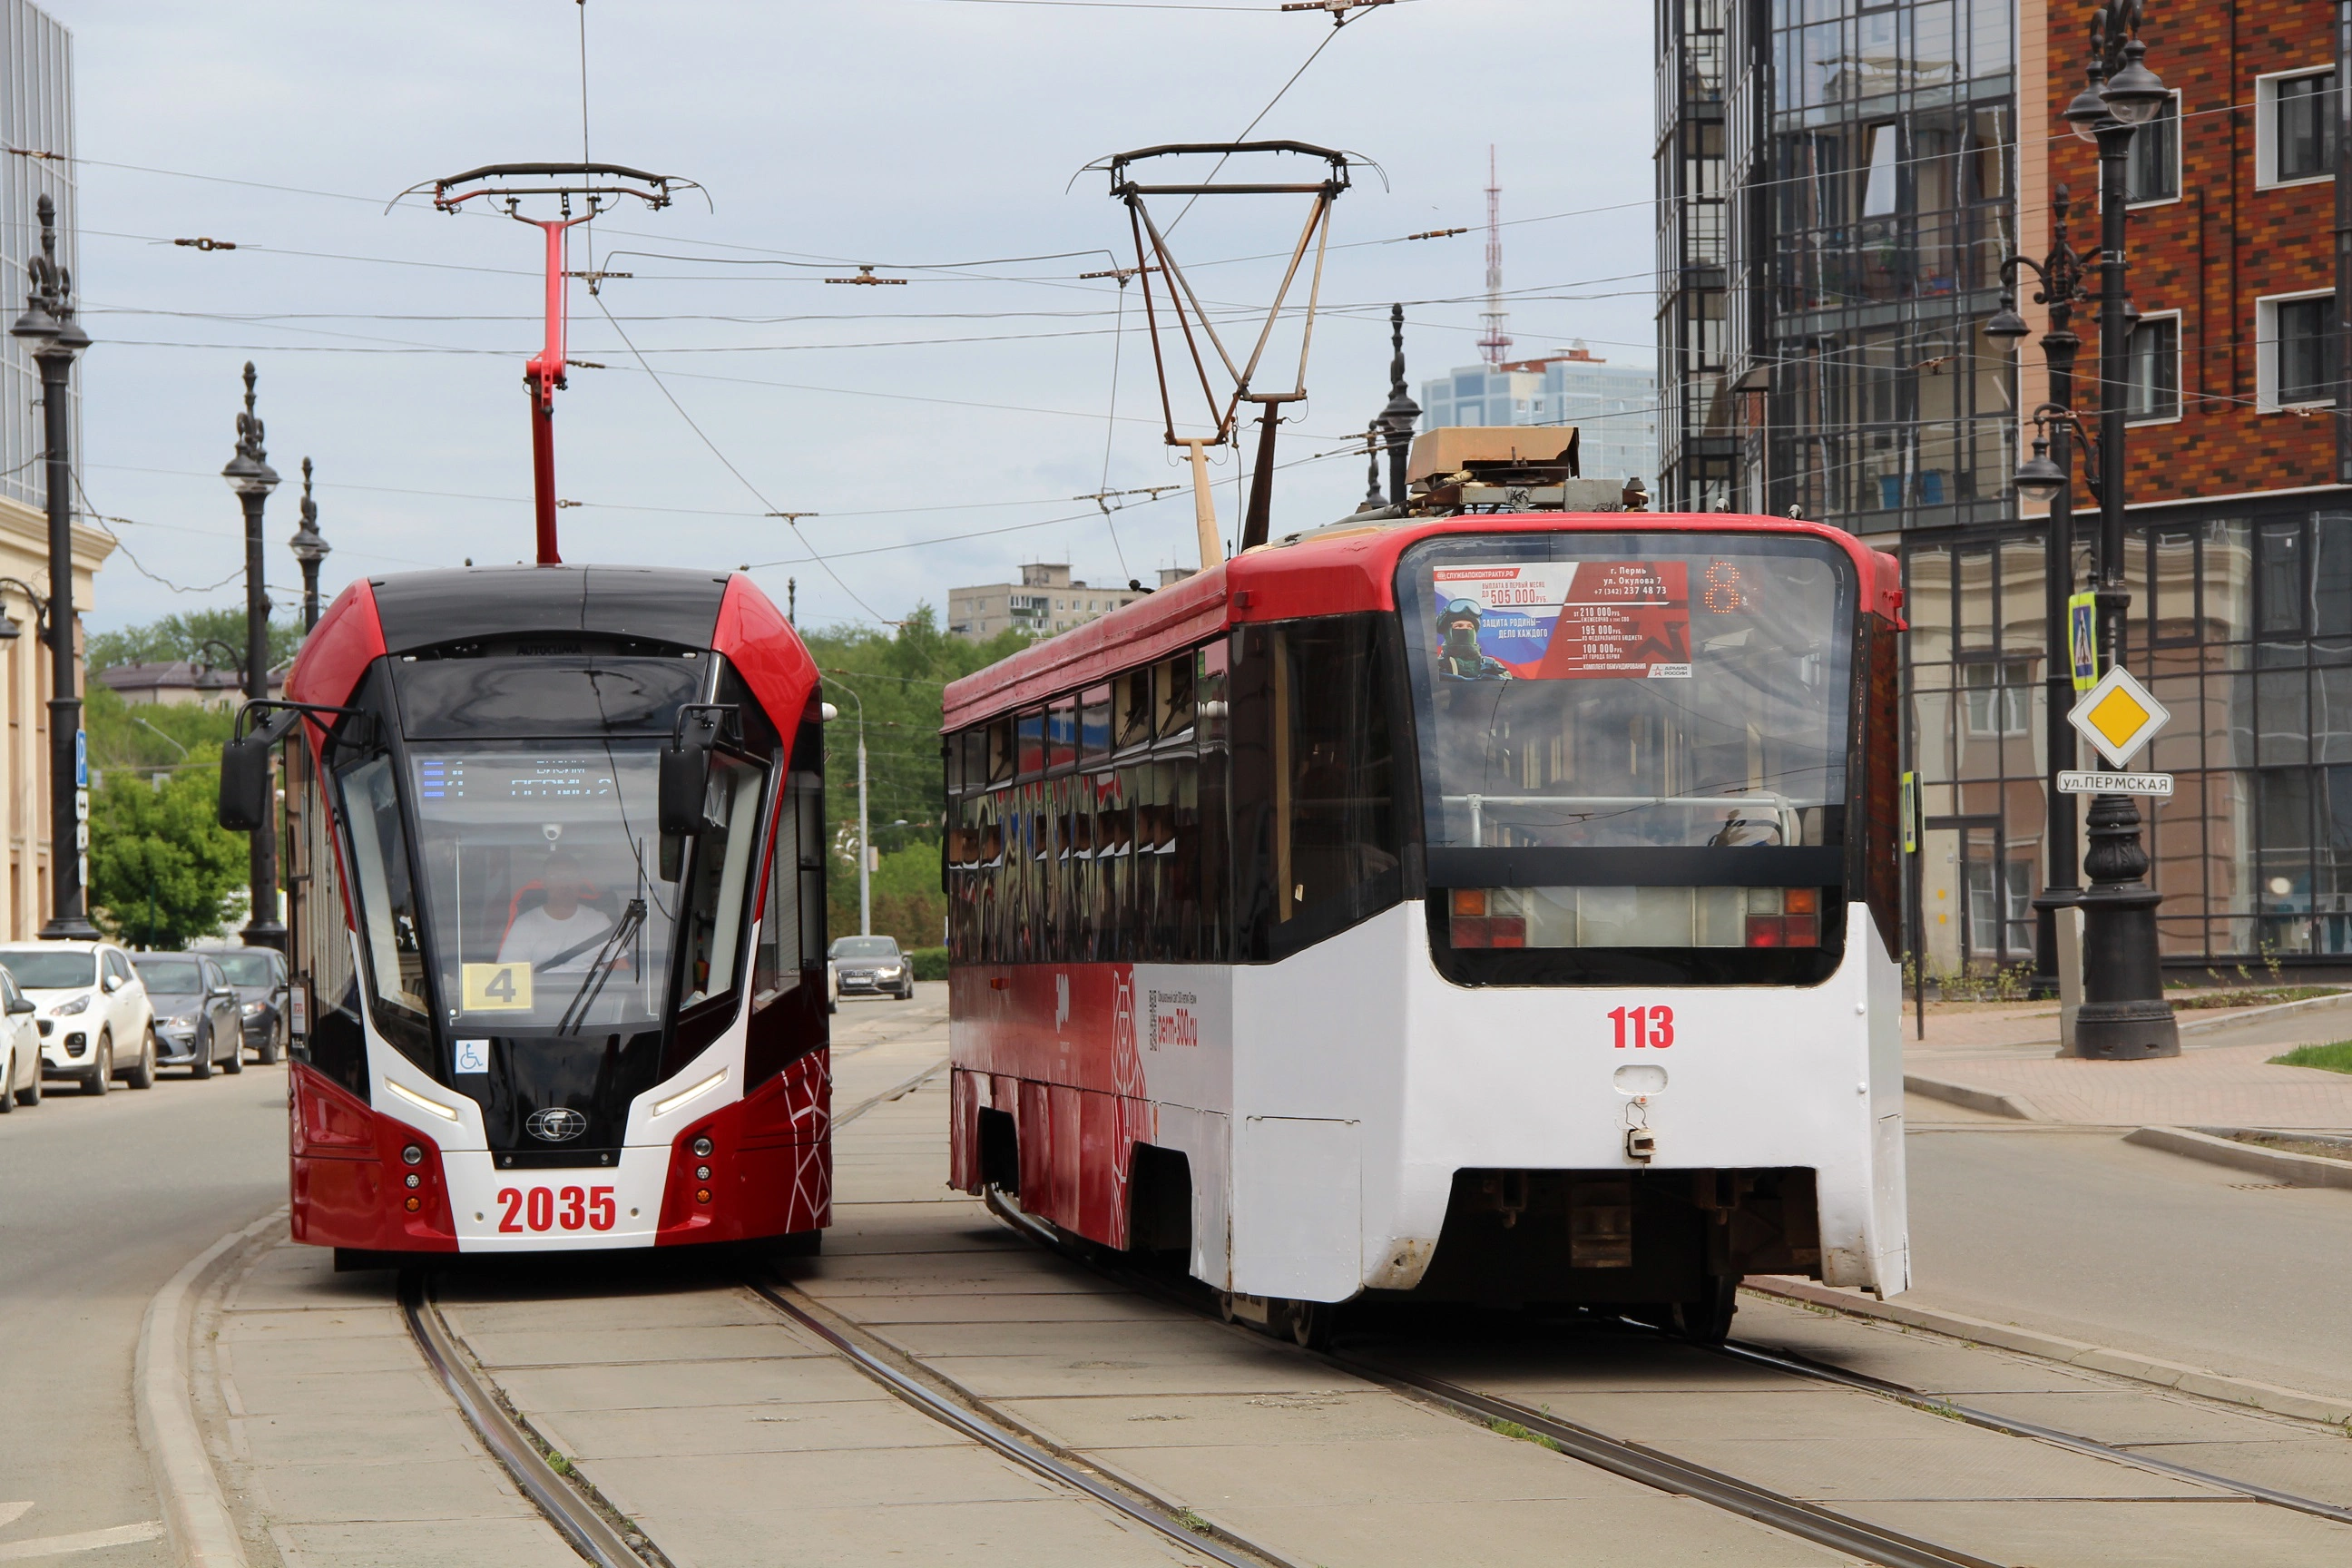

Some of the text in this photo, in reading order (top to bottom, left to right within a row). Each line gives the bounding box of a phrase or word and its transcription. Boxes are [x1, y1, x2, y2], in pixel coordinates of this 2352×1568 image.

[1446, 570, 1514, 579] СЛУЖБАПОКОНТРАКТУ.РФ
[1619, 566, 1647, 576] Пермь
[1603, 576, 1661, 586] ул. Окулова 7
[1623, 586, 1640, 594] 237
[1642, 586, 1653, 594] 48
[1656, 586, 1667, 594] 73
[1704, 561, 1740, 614] 8
[1481, 590, 1489, 598] ДО
[1491, 589, 1511, 603] 505
[1514, 589, 1535, 603] 000
[1580, 607, 1594, 617] 210
[1596, 606, 1612, 617] 000
[1482, 619, 1508, 628] ЗАЩИТА
[1498, 628, 1548, 639] ДЕЛО КАЖДОГО
[1582, 625, 1595, 635] 195
[1598, 624, 1612, 635] 000
[1583, 643, 1597, 653] 100
[1599, 643, 1614, 653] 000
[485, 967, 516, 1004] 4
[1158, 1008, 1198, 1053] perm-300.ru
[1607, 1004, 1675, 1050] 113
[497, 1184, 616, 1234] 2035
